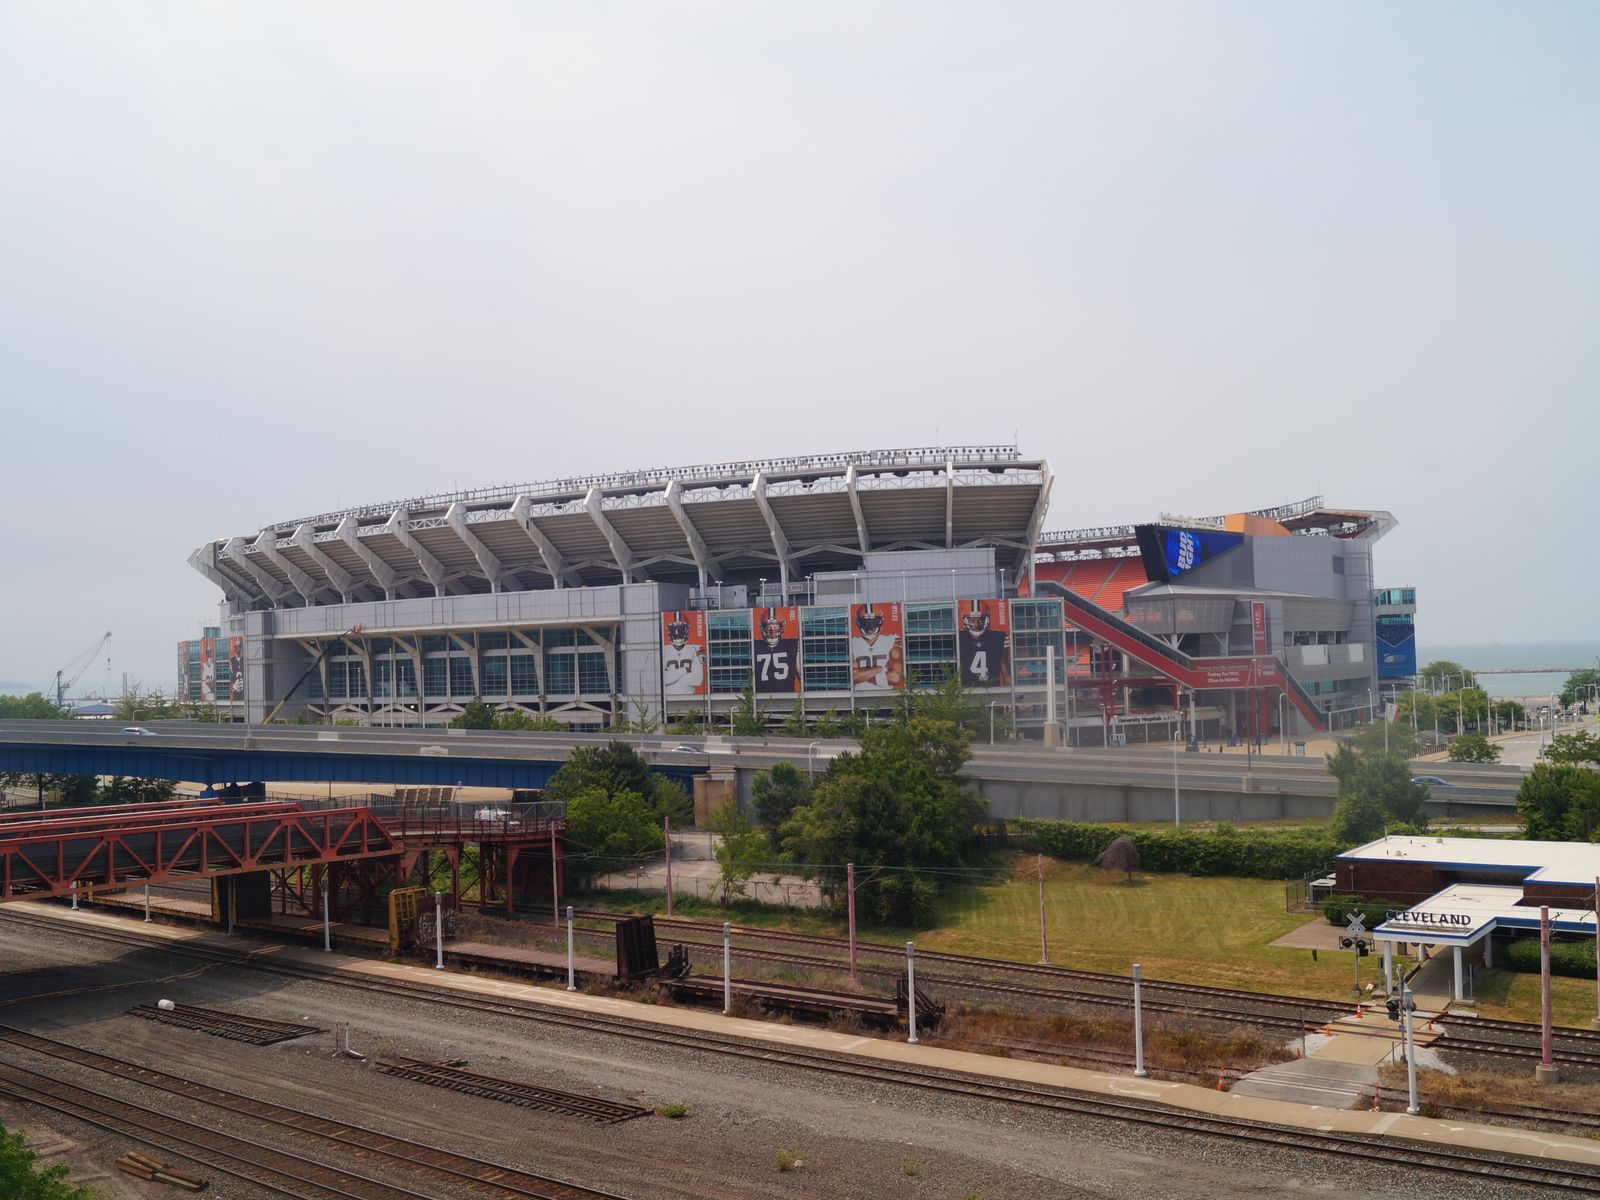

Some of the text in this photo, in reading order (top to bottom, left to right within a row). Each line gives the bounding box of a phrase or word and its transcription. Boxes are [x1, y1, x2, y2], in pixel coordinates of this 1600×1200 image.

[1177, 531, 1187, 570] BUD
[756, 652, 789, 681] 75
[970, 651, 989, 681] 4
[1385, 910, 1472, 925] CLEVELAND
